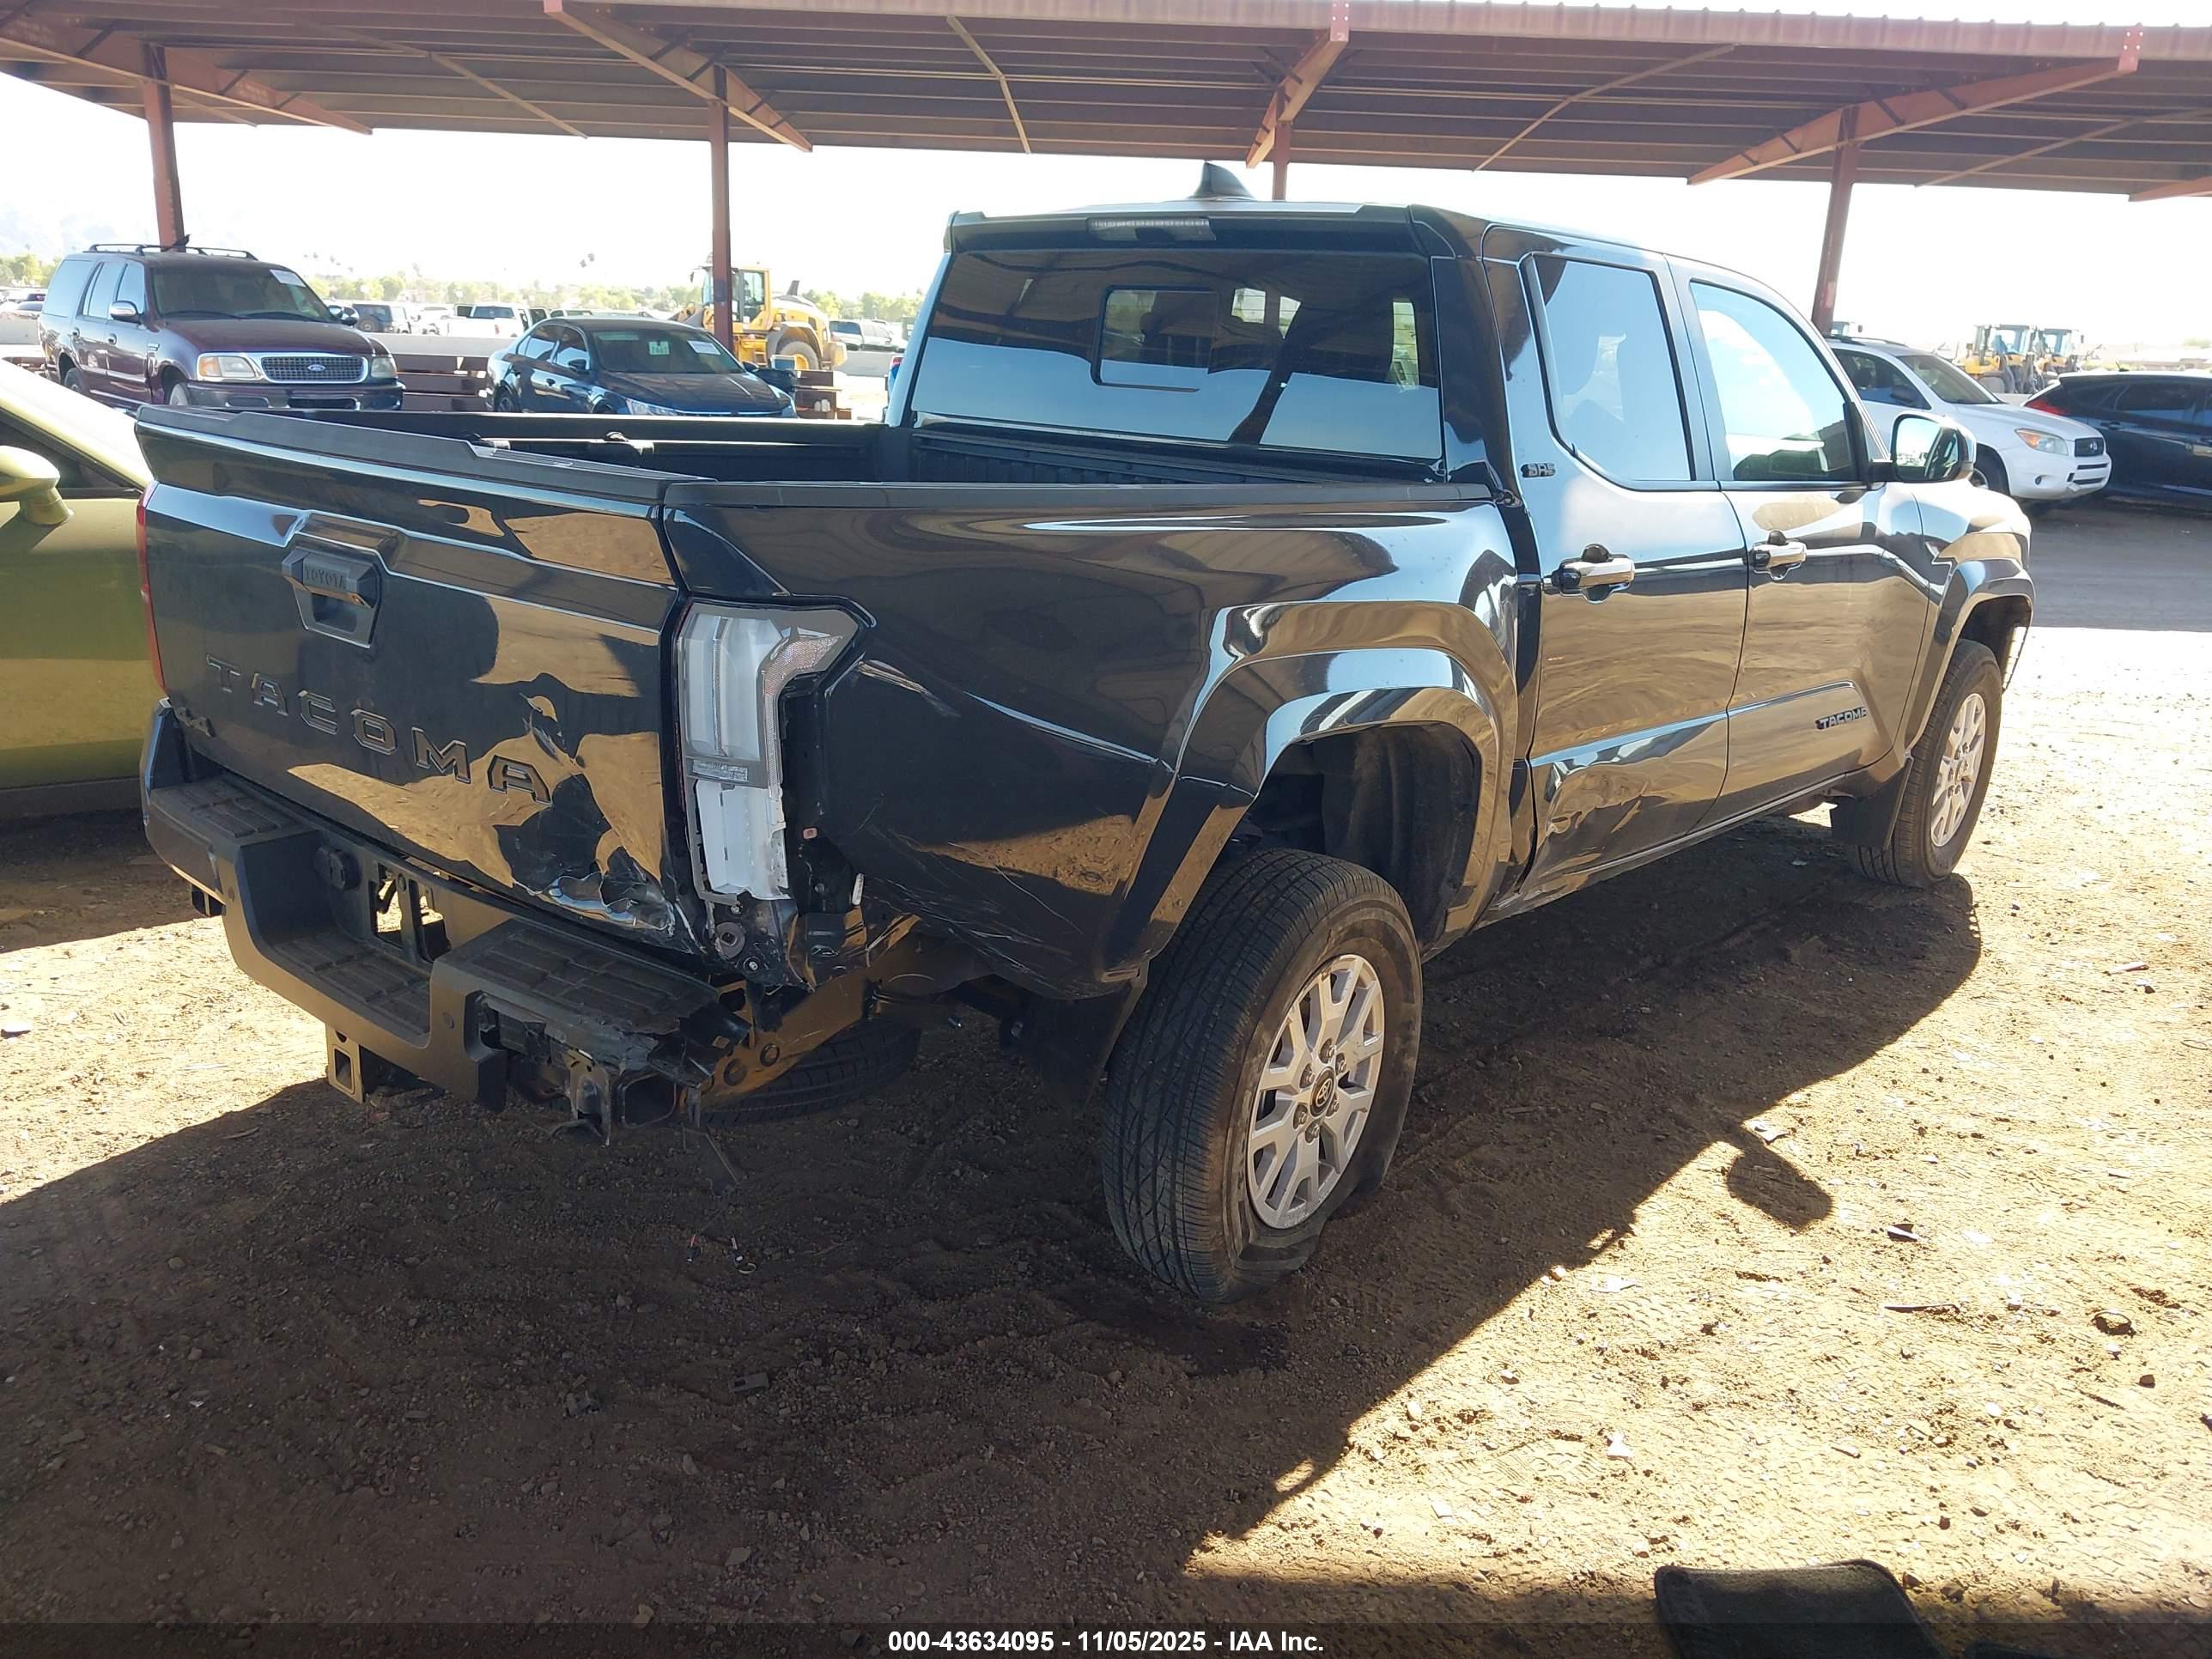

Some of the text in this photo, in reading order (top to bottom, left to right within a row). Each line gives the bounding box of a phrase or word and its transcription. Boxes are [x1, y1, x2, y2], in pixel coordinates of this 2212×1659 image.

[304, 568, 347, 590] TOYOTA
[1815, 706, 1869, 729] TACOMA
[206, 653, 551, 806] TACOMA
